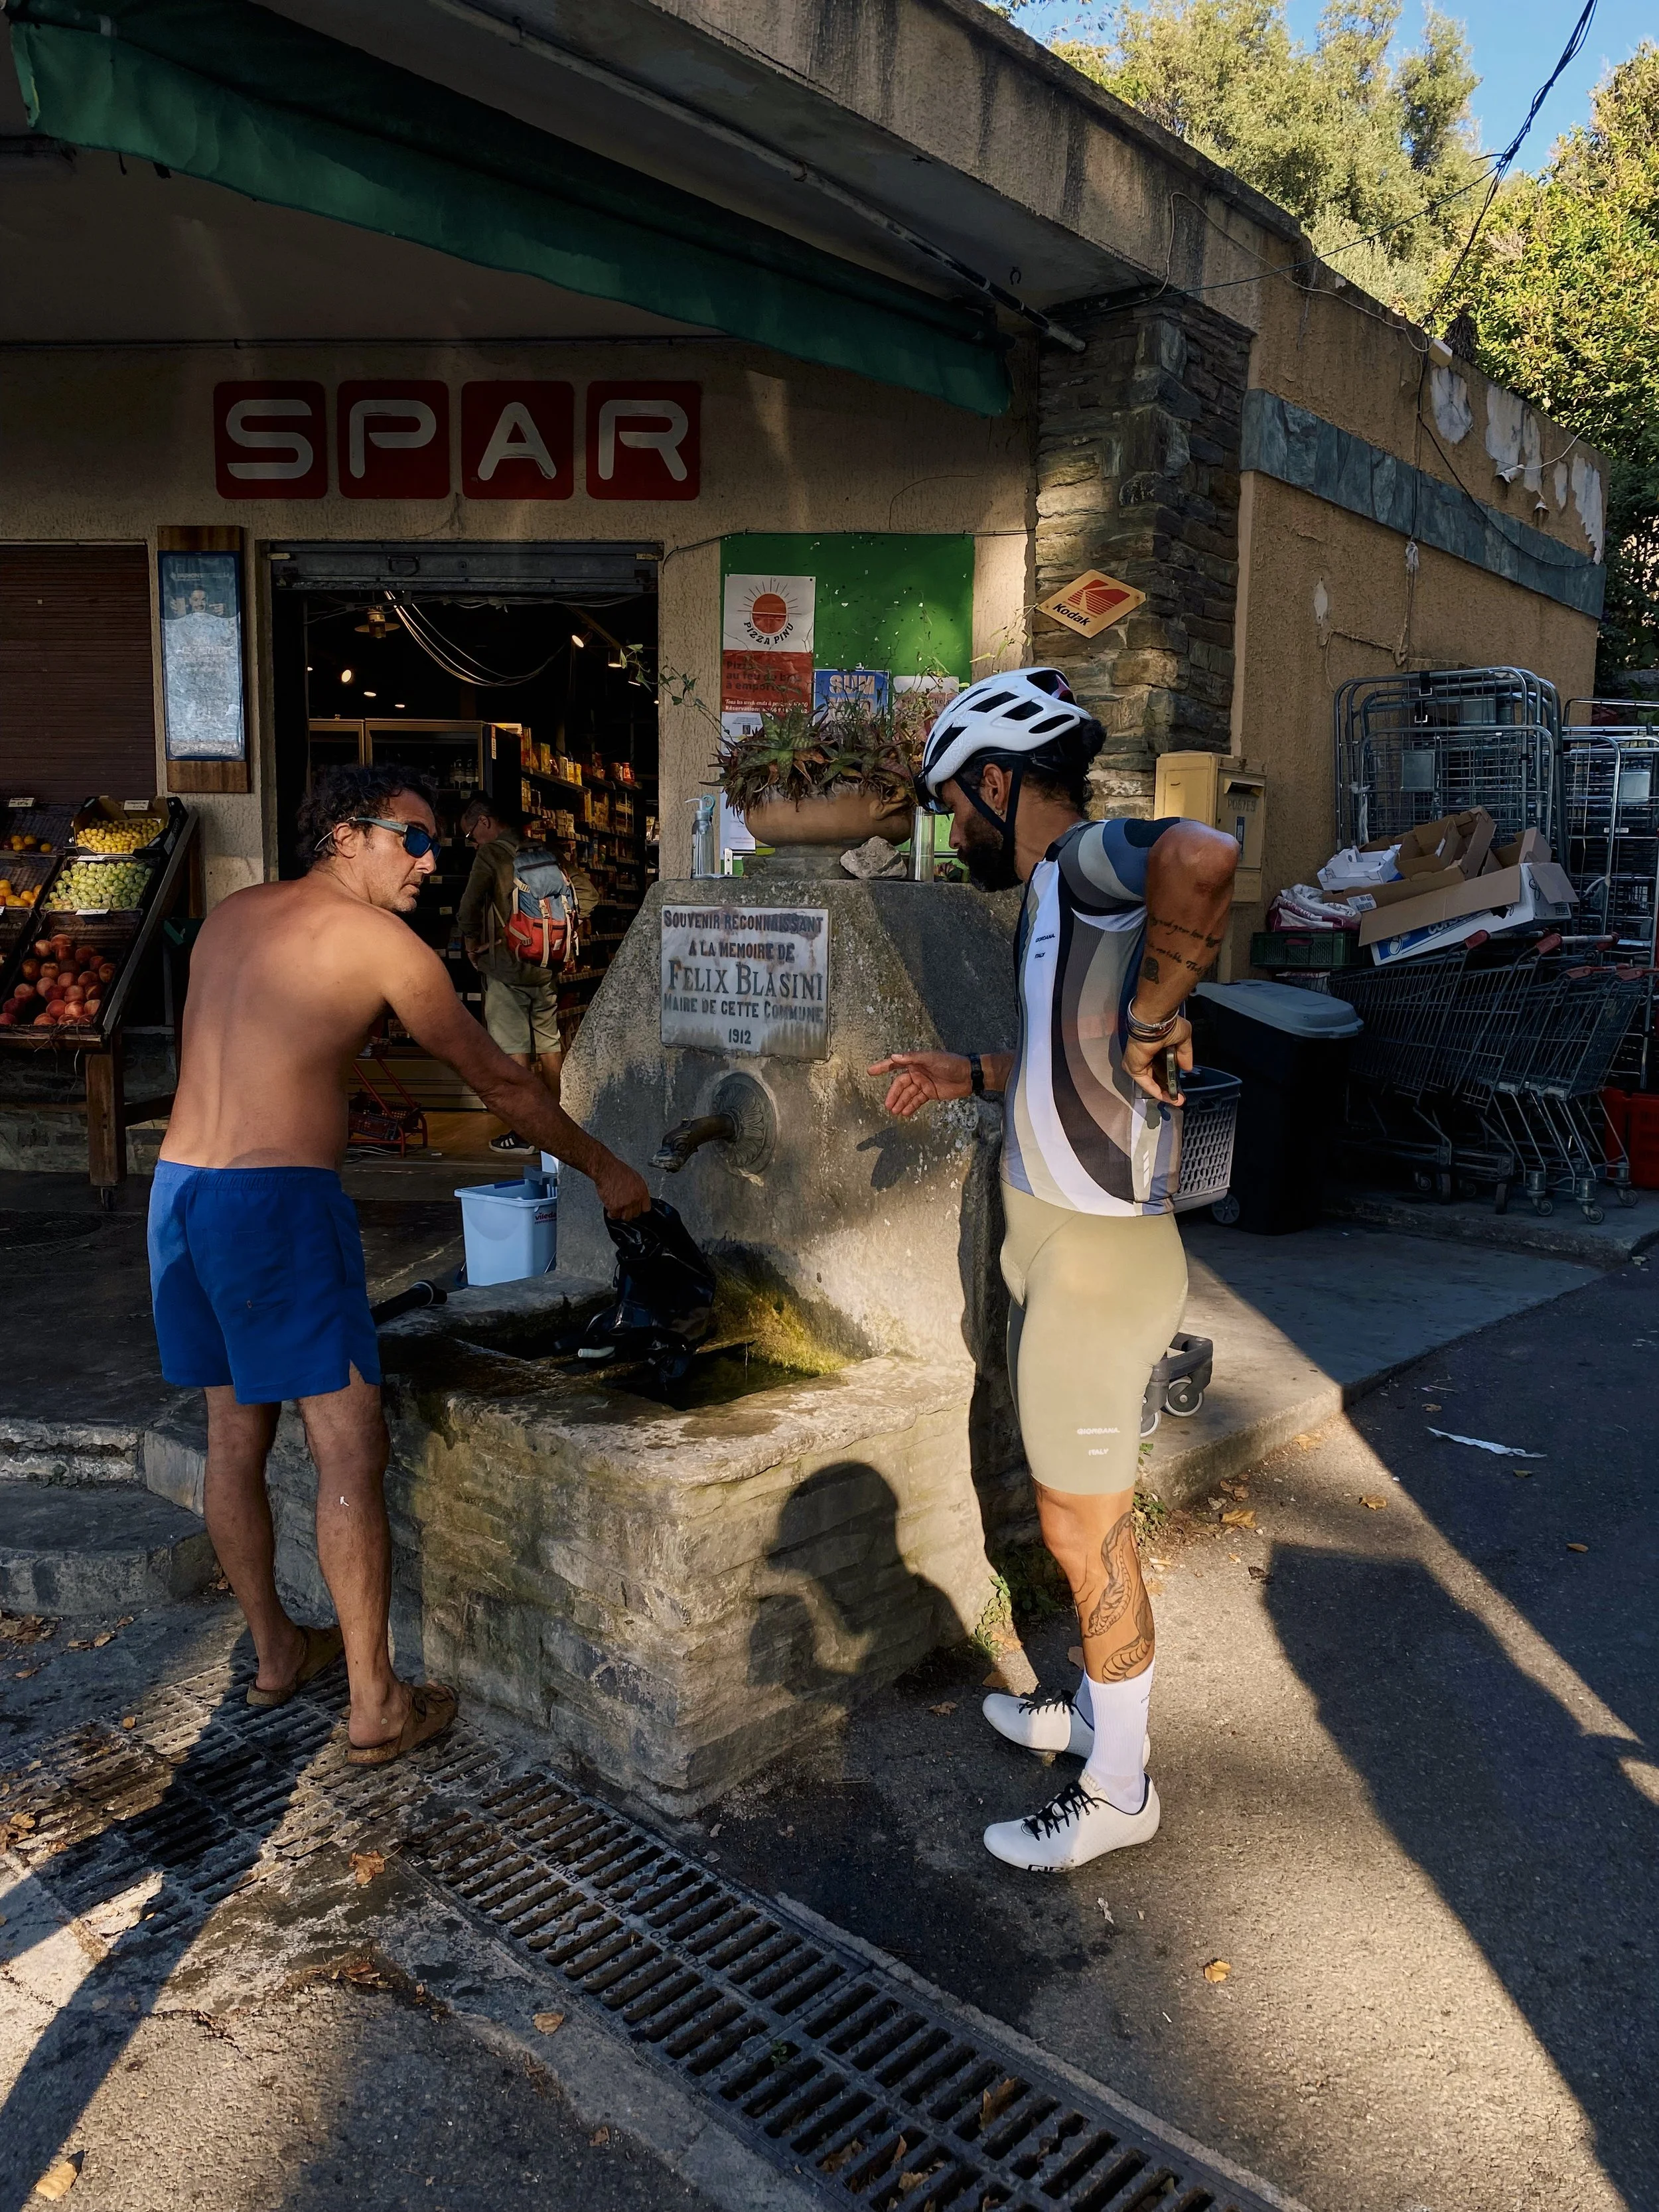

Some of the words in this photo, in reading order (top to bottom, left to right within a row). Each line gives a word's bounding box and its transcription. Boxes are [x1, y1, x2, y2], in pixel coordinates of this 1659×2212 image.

[226, 399, 689, 481] SPAR
[1052, 603, 1091, 626] Kodak
[744, 621, 770, 644] PIZZA
[774, 623, 794, 644] PINU
[735, 684, 790, 693] emport
[1226, 798, 1256, 812] POSTES
[664, 910, 720, 929] SOUVENIR
[724, 912, 824, 934] RECONNAISSANT
[688, 940, 697, 956] A
[700, 941, 715, 957] LA
[719, 942, 774, 960] MEMOIRE
[777, 942, 795, 962] DE
[668, 959, 729, 994] FELIX
[735, 962, 823, 1001] BLASINI
[664, 993, 697, 1013] MAIRE
[701, 998, 717, 1015] DE
[721, 1000, 759, 1018] CETTE
[764, 1001, 824, 1023] COMMUNE
[729, 1028, 752, 1045] 1912
[536, 1211, 557, 1220] vileda
